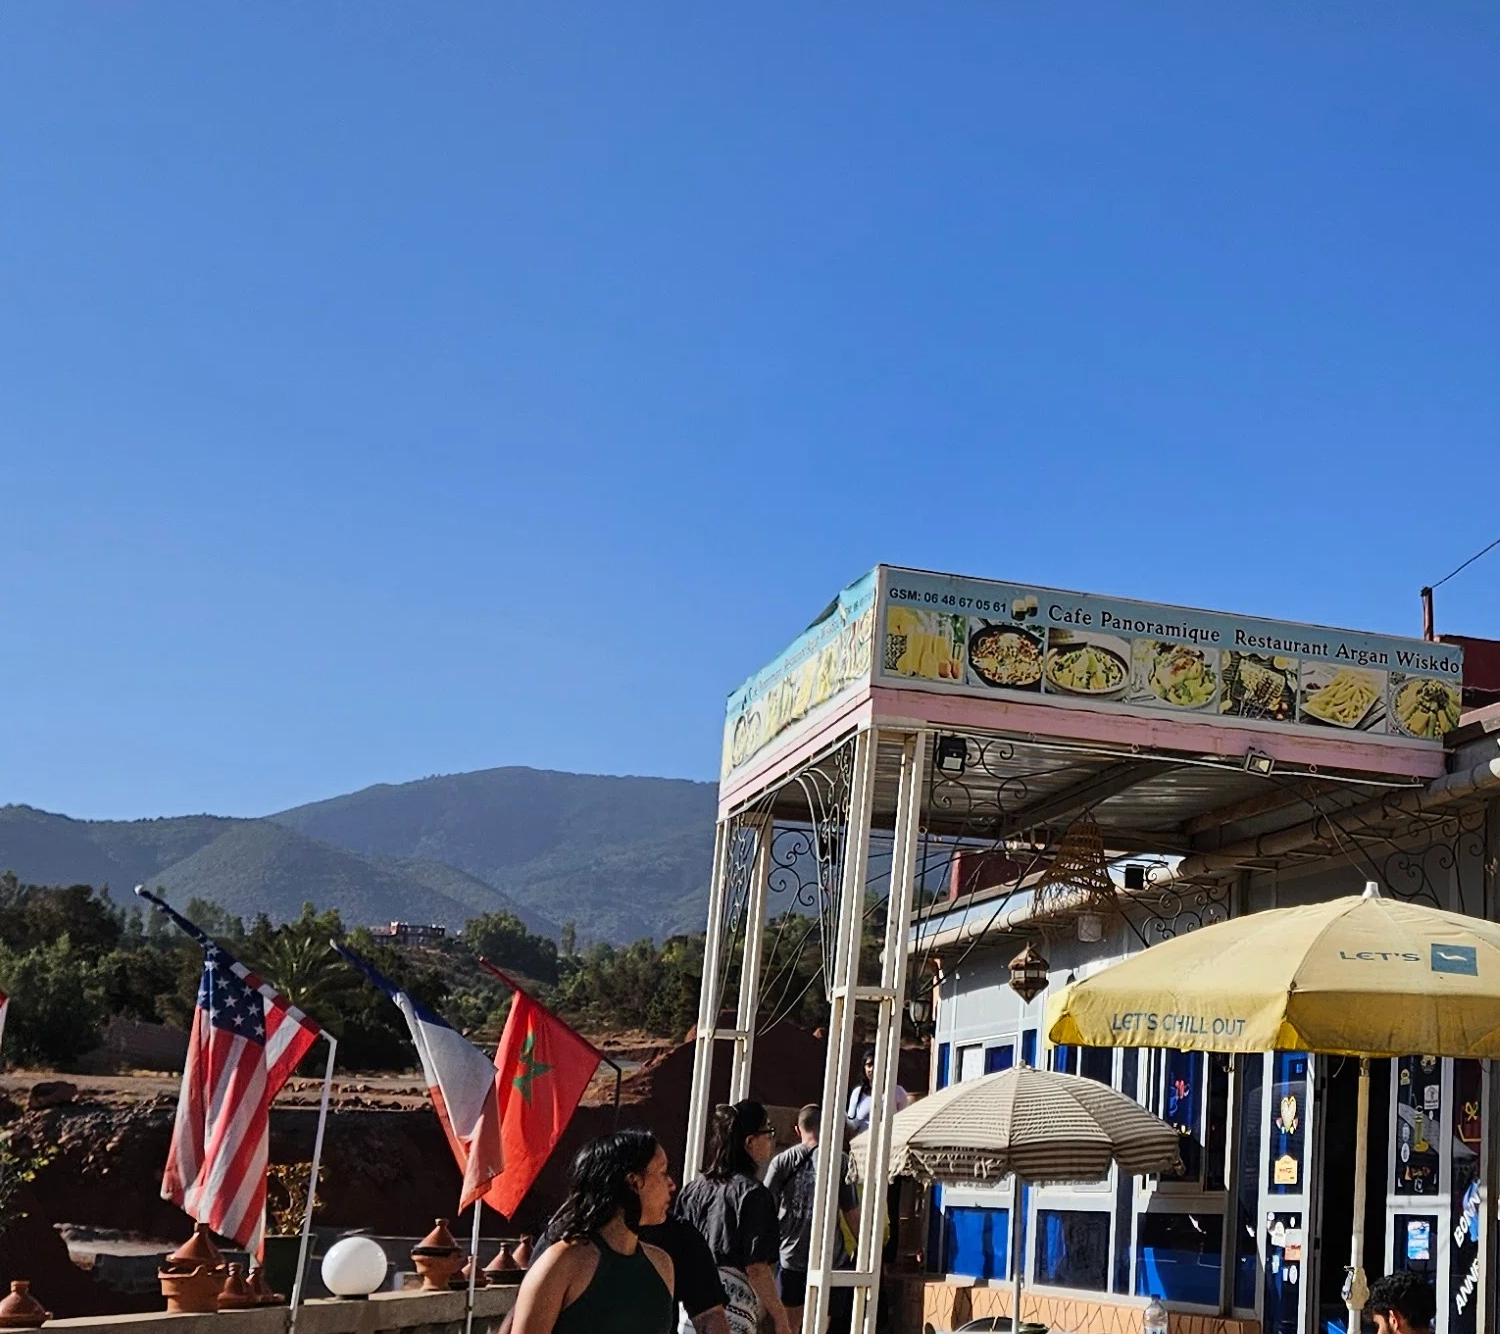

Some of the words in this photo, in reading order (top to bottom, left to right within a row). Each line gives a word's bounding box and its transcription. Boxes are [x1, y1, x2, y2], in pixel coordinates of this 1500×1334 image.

[889, 588, 921, 602] GSM:
[924, 592, 938, 604] 06
[942, 594, 956, 606] 48
[959, 597, 973, 609] 67
[976, 599, 990, 611] 05
[993, 602, 1007, 613] 61
[1049, 604, 1092, 625] Cafe
[1101, 610, 1221, 644] Panoramique
[1234, 629, 1328, 656] Restaurant
[1335, 643, 1389, 666] Argan
[1339, 951, 1420, 962] LET'S
[1112, 1012, 1158, 1032] LET'S
[1162, 1013, 1208, 1034] CHILL
[1213, 1018, 1246, 1036] OUT
